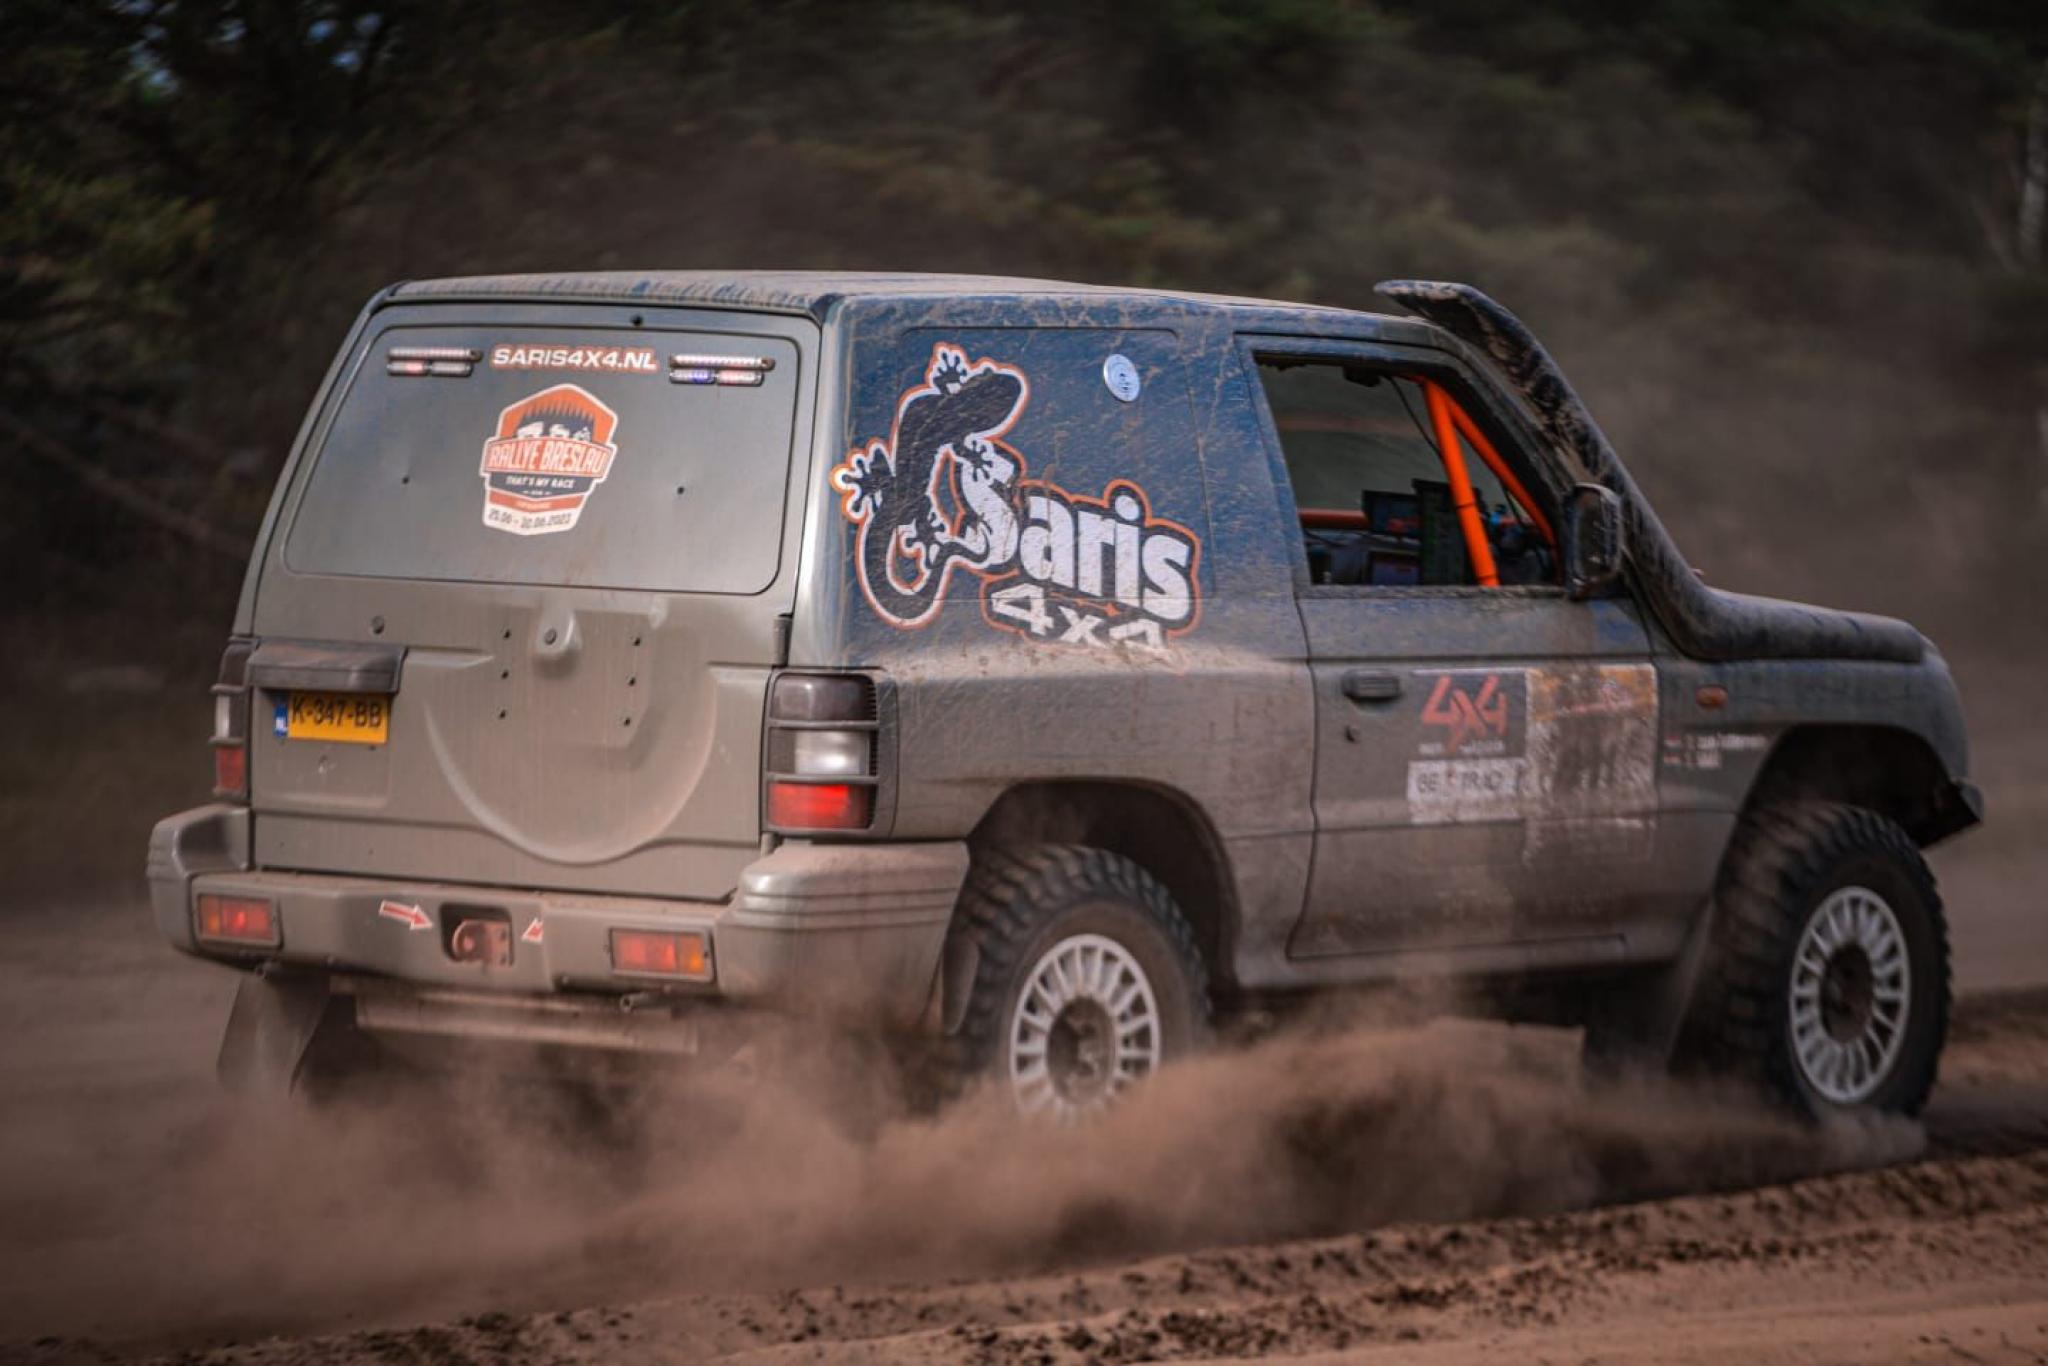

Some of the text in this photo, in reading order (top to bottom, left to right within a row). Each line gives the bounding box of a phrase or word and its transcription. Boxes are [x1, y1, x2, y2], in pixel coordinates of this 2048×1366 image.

[492, 348, 657, 370] SARIS4X4.NL
[487, 439, 609, 474] RALLYE BRESLAU
[551, 478, 575, 489] RACE
[956, 442, 1190, 620] Saris
[991, 583, 1168, 656] 4x4
